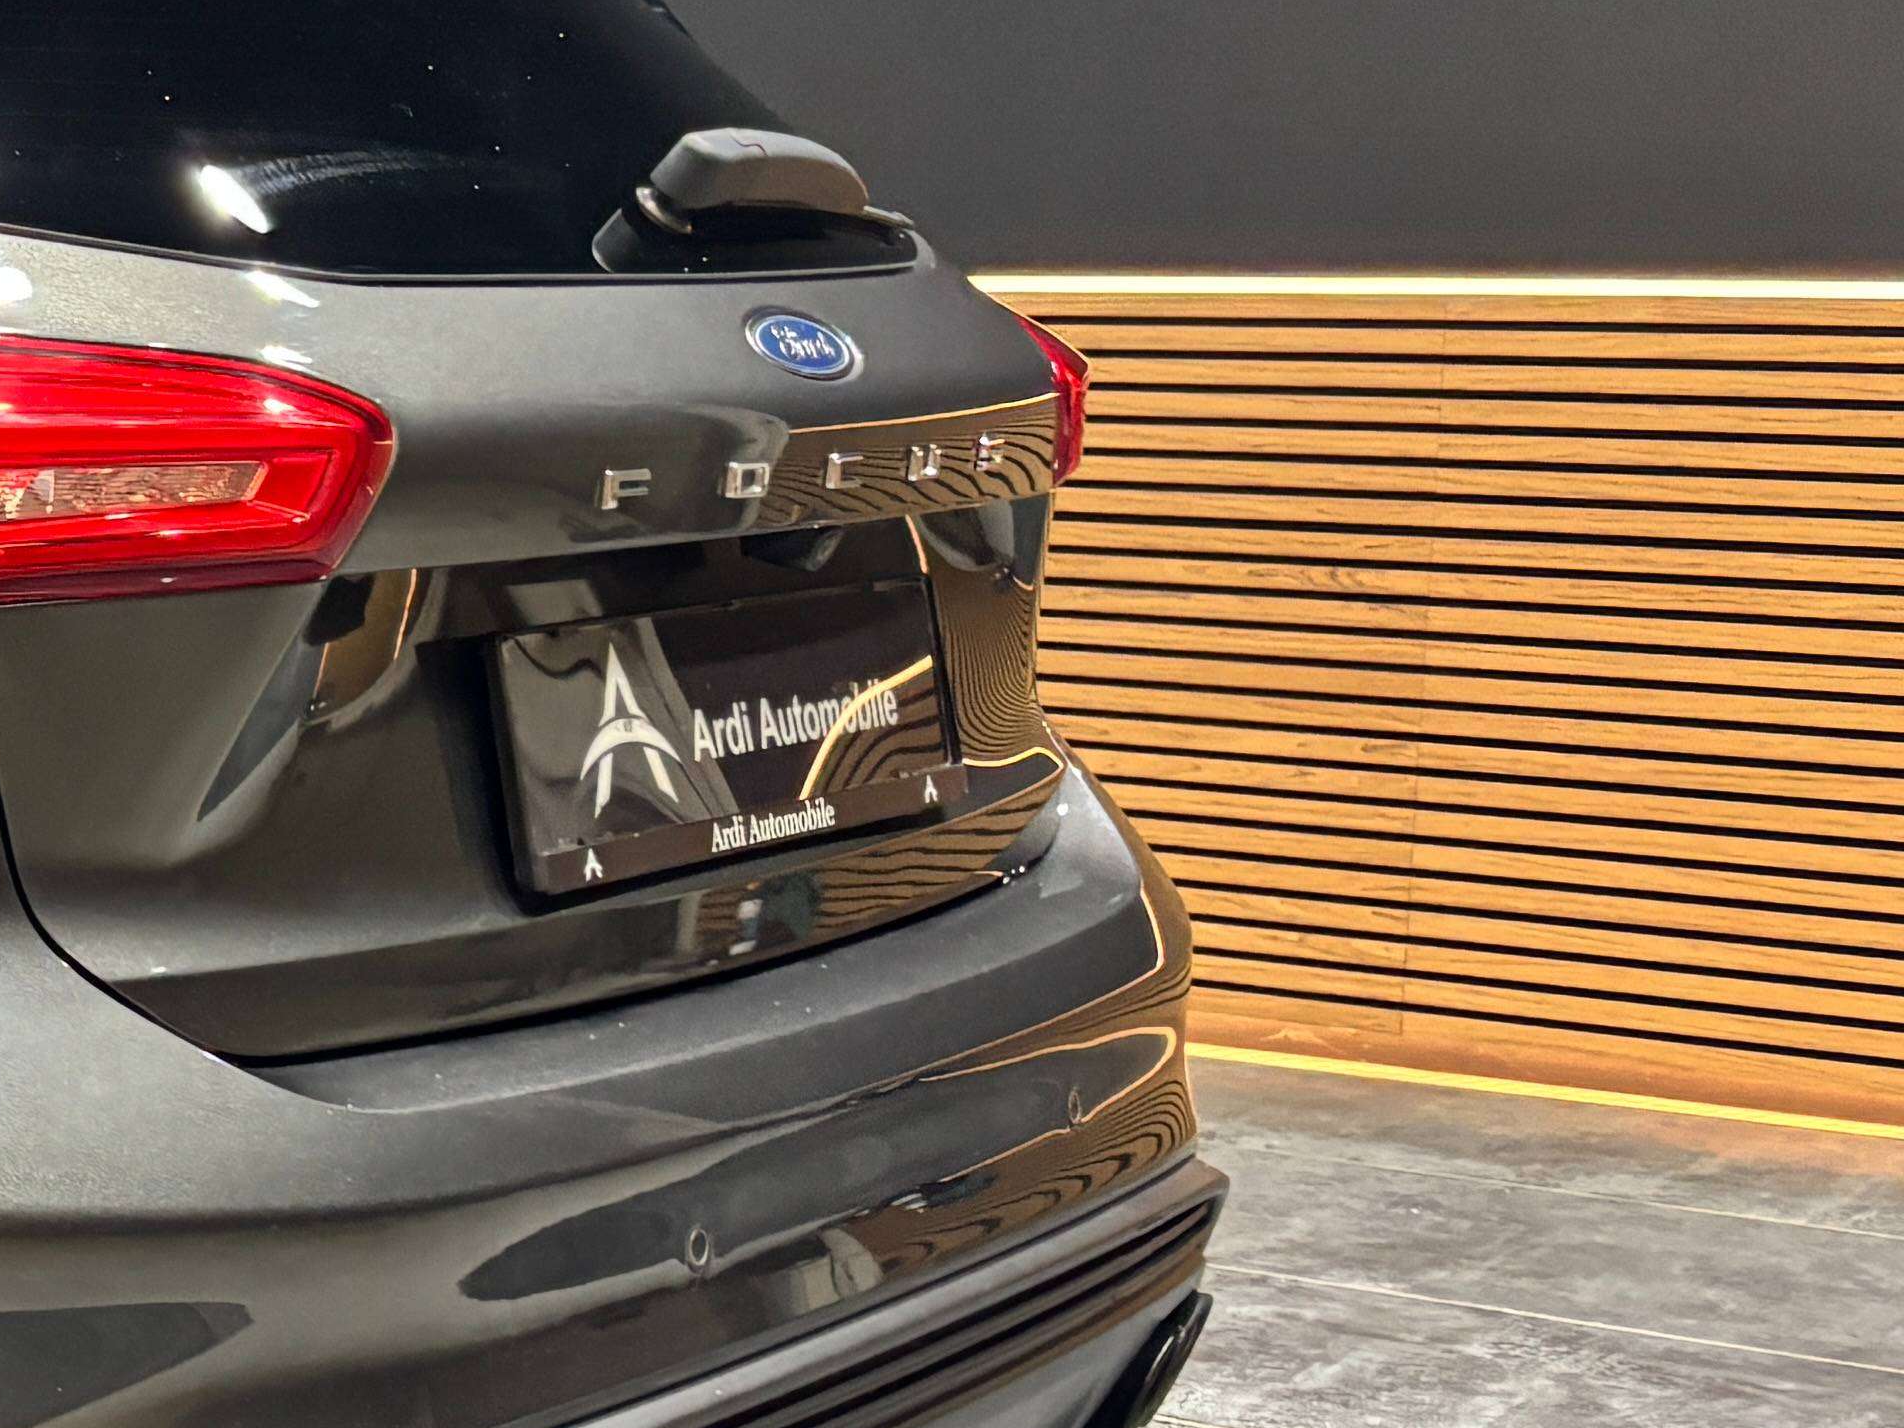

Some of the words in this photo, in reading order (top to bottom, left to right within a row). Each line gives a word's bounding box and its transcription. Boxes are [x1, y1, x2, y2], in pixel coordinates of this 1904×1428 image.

[694, 700, 756, 762] Ardi
[759, 677, 899, 750] Automobile
[711, 815, 748, 853] Ardi
[749, 797, 836, 845] Automobile
